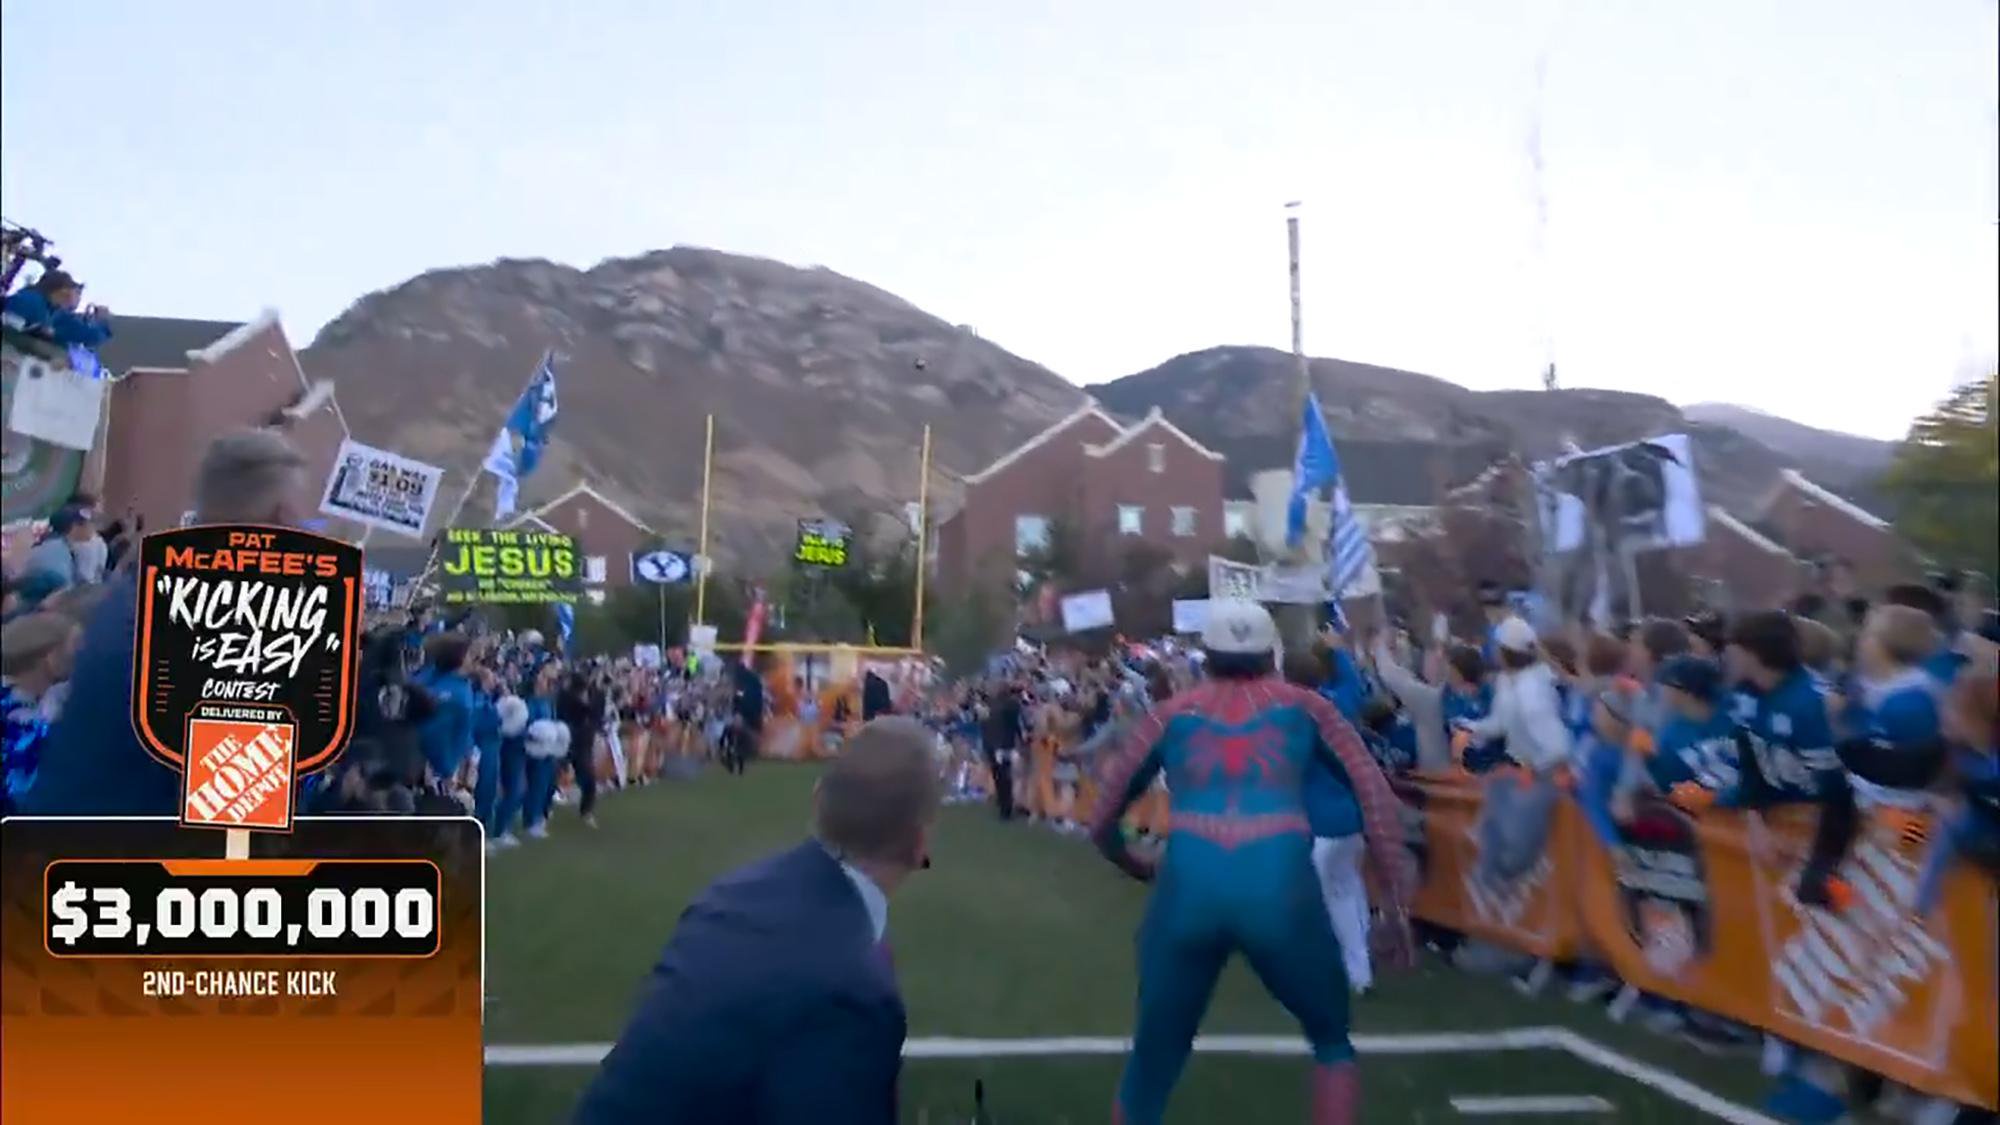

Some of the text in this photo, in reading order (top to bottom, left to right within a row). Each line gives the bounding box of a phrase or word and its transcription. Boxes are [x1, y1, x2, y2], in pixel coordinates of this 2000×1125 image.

[447, 529, 573, 548] SEEK THE LIVING
[443, 545, 573, 578] JESUS
[649, 555, 678, 578] Y
[795, 545, 846, 566] JESUS
